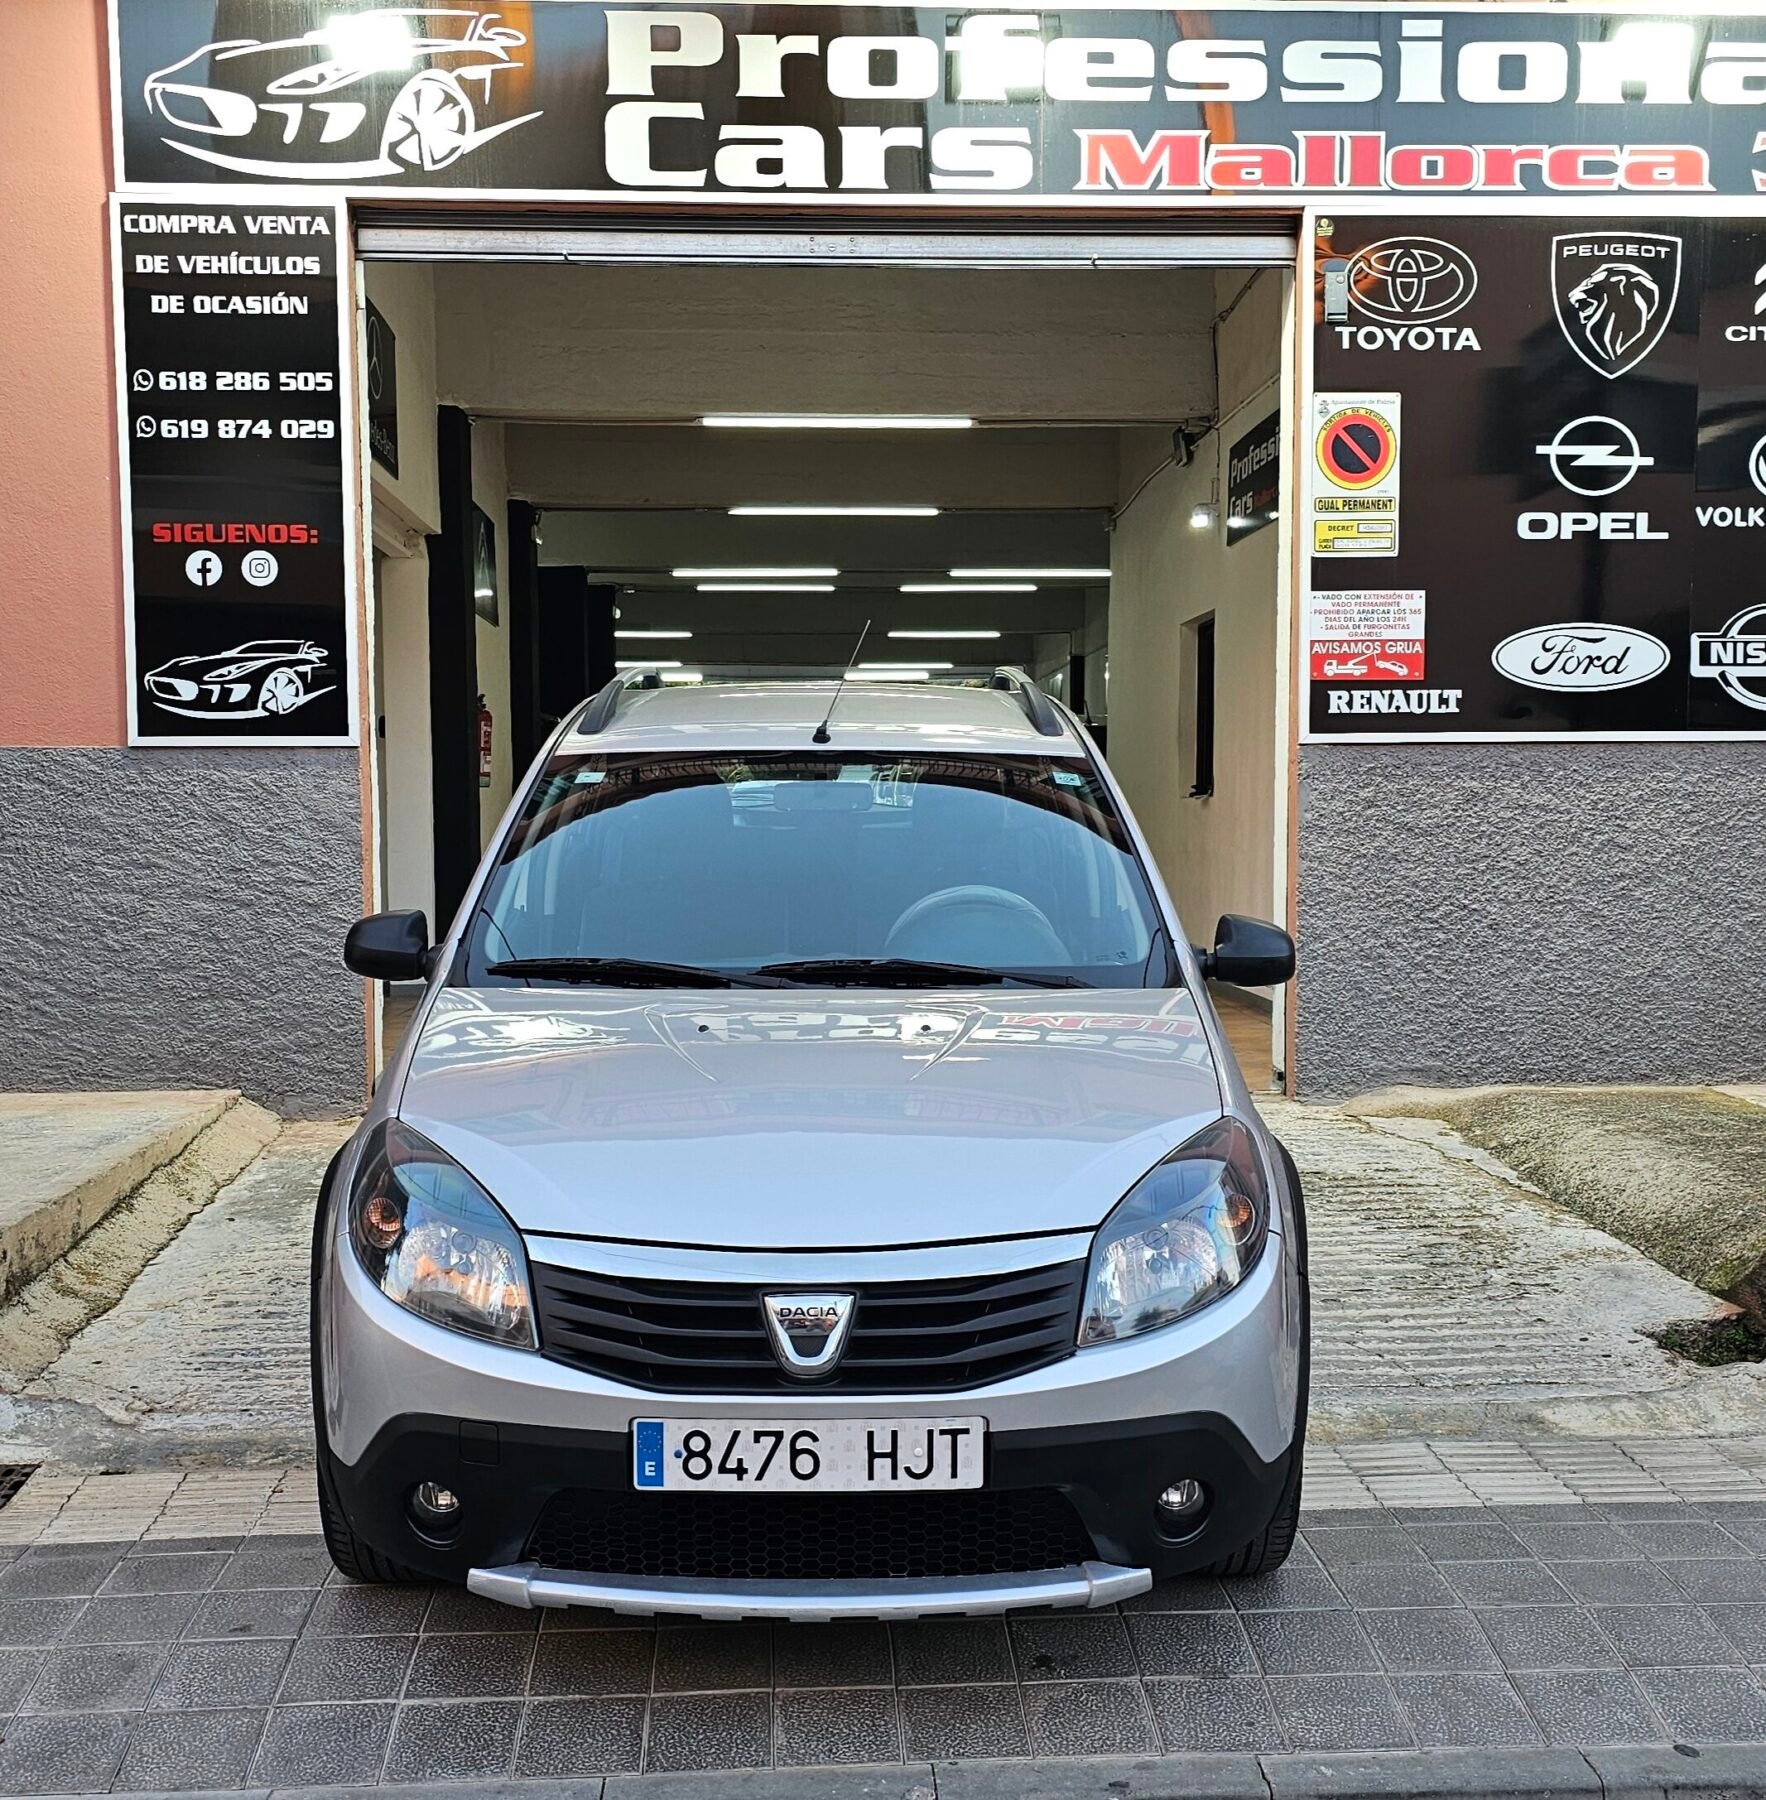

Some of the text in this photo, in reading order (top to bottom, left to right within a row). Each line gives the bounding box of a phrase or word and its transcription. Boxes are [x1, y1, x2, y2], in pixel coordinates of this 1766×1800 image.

[604, 101, 1033, 190] Cars
[1072, 129, 1717, 191] Mallorca
[124, 214, 331, 235] COMPRA VENTA
[1563, 243, 1671, 260] PEUGEOT
[135, 250, 321, 276] DE VEHÍCULOS
[150, 290, 309, 315] DE OCASIÓN
[1335, 326, 1482, 351] TOYOTA
[158, 371, 334, 391] 618 286 505
[160, 419, 335, 439] 619 874 029
[1317, 499, 1393, 511] GUAL PERMANENT
[153, 523, 319, 544] SIGUENOS:
[1517, 512, 1669, 540] OPEL
[1364, 592, 1403, 600] EXTENSIÓN
[1312, 641, 1423, 654] AVISAMOS GRUA
[1531, 634, 1632, 676] Ford
[1328, 689, 1462, 714] RENAULT
[779, 1306, 838, 1318] DACIA
[681, 1427, 971, 1481] 8476 HJT
[644, 1461, 656, 1476] E
